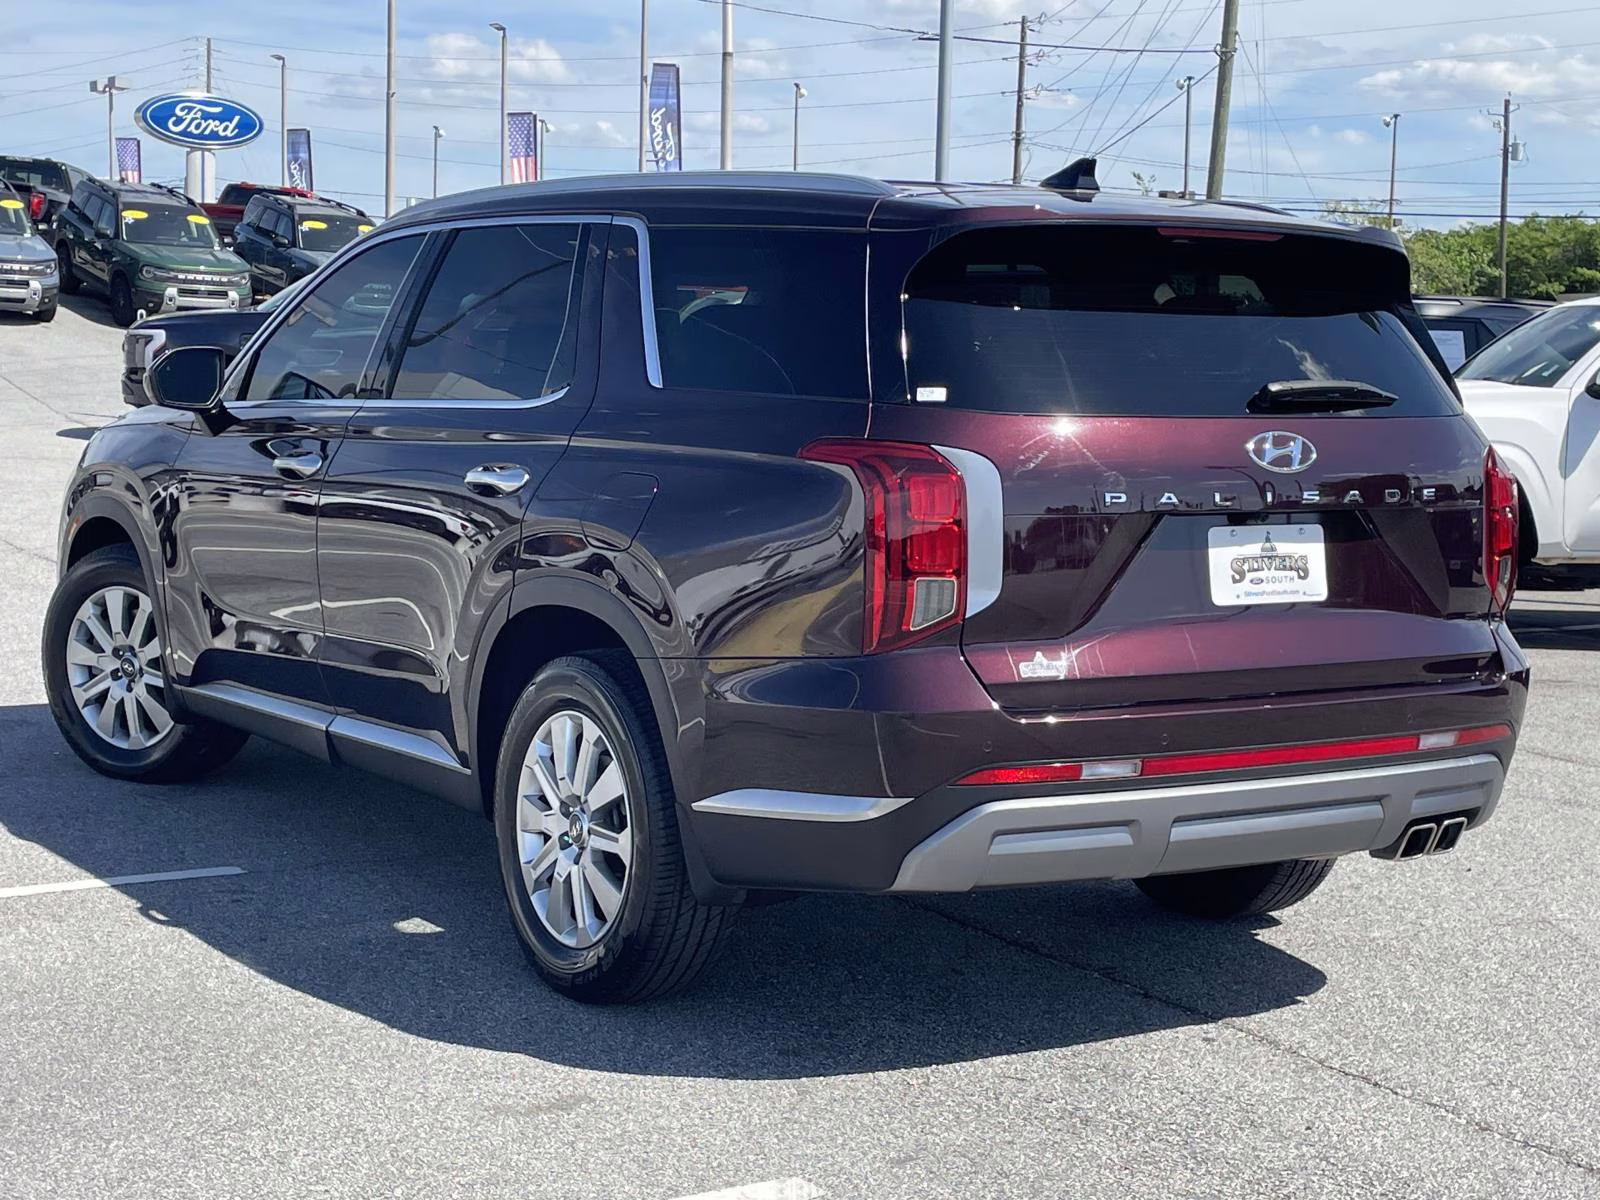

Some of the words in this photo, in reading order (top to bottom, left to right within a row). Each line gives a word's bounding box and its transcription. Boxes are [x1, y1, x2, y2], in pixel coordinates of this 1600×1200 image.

[168, 102, 241, 137] Ford
[1104, 488, 1436, 507] PALISADE
[1230, 554, 1310, 585] STIVERS
[1265, 575, 1295, 584] SOUTH
